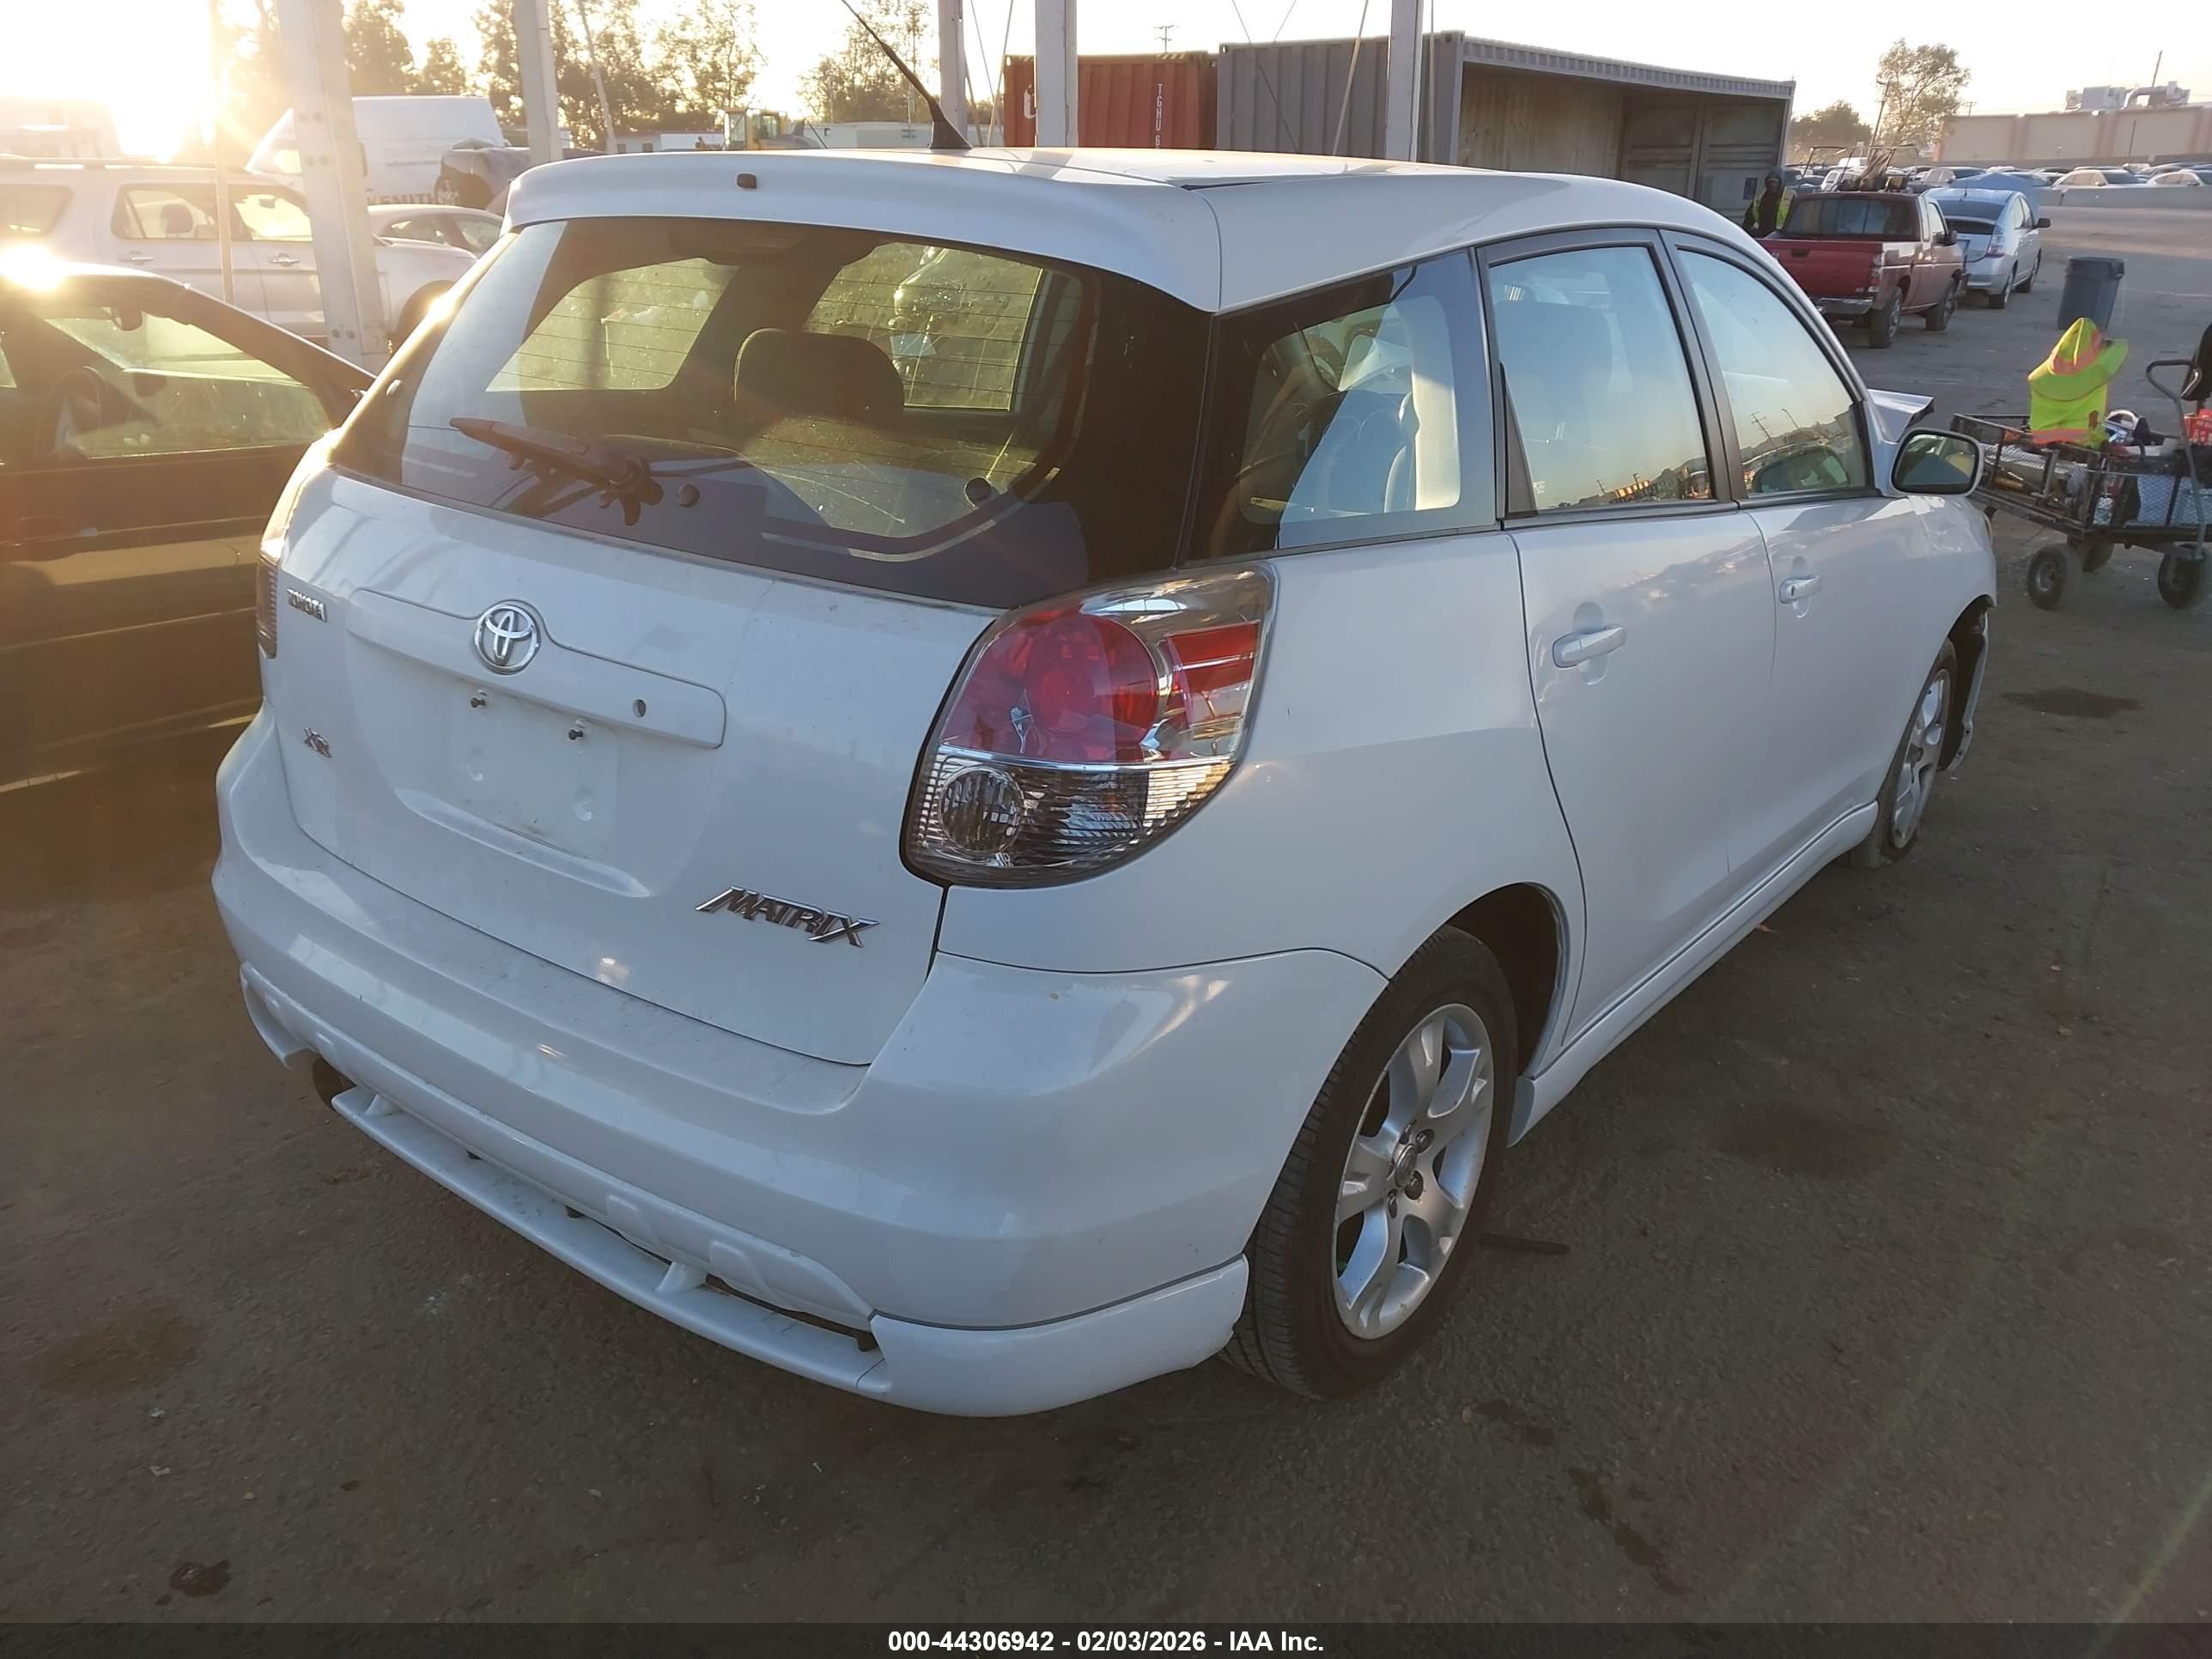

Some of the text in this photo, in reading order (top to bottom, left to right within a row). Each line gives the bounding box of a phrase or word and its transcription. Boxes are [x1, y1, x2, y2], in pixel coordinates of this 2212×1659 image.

[1155, 83, 1164, 131] TGHU
[287, 587, 327, 623] TOYOTA
[694, 884, 880, 949] MATRIX
